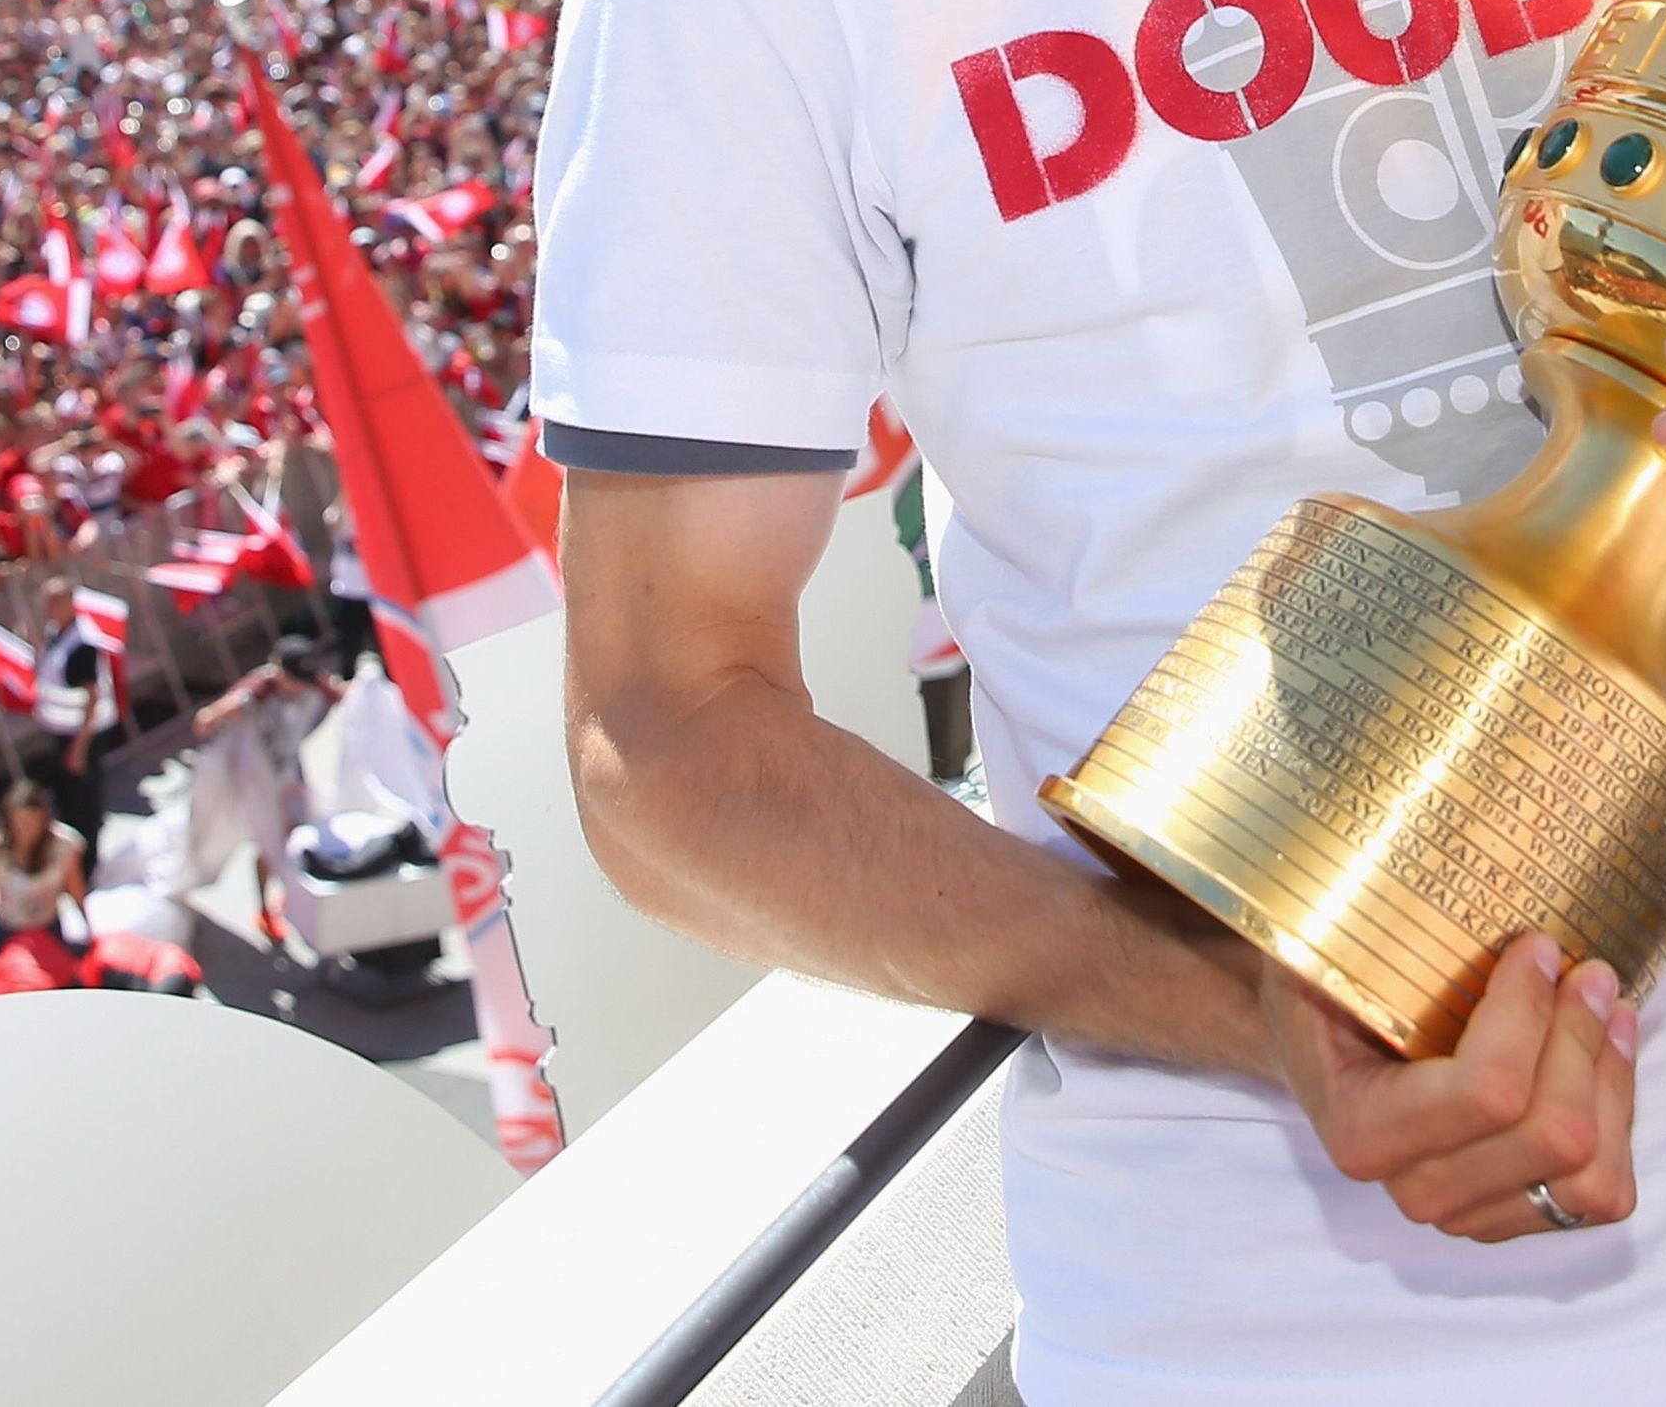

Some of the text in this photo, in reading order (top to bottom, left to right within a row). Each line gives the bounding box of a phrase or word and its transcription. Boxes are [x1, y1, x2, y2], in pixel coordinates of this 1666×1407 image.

[1558, 711, 1605, 753] 1973
[1509, 704, 1652, 822] HAMBURGER
[1547, 763, 1589, 802] 1981
[1475, 739, 1511, 767] FC
[1517, 768, 1596, 837] BAYER
[1521, 898, 1551, 925] 04
